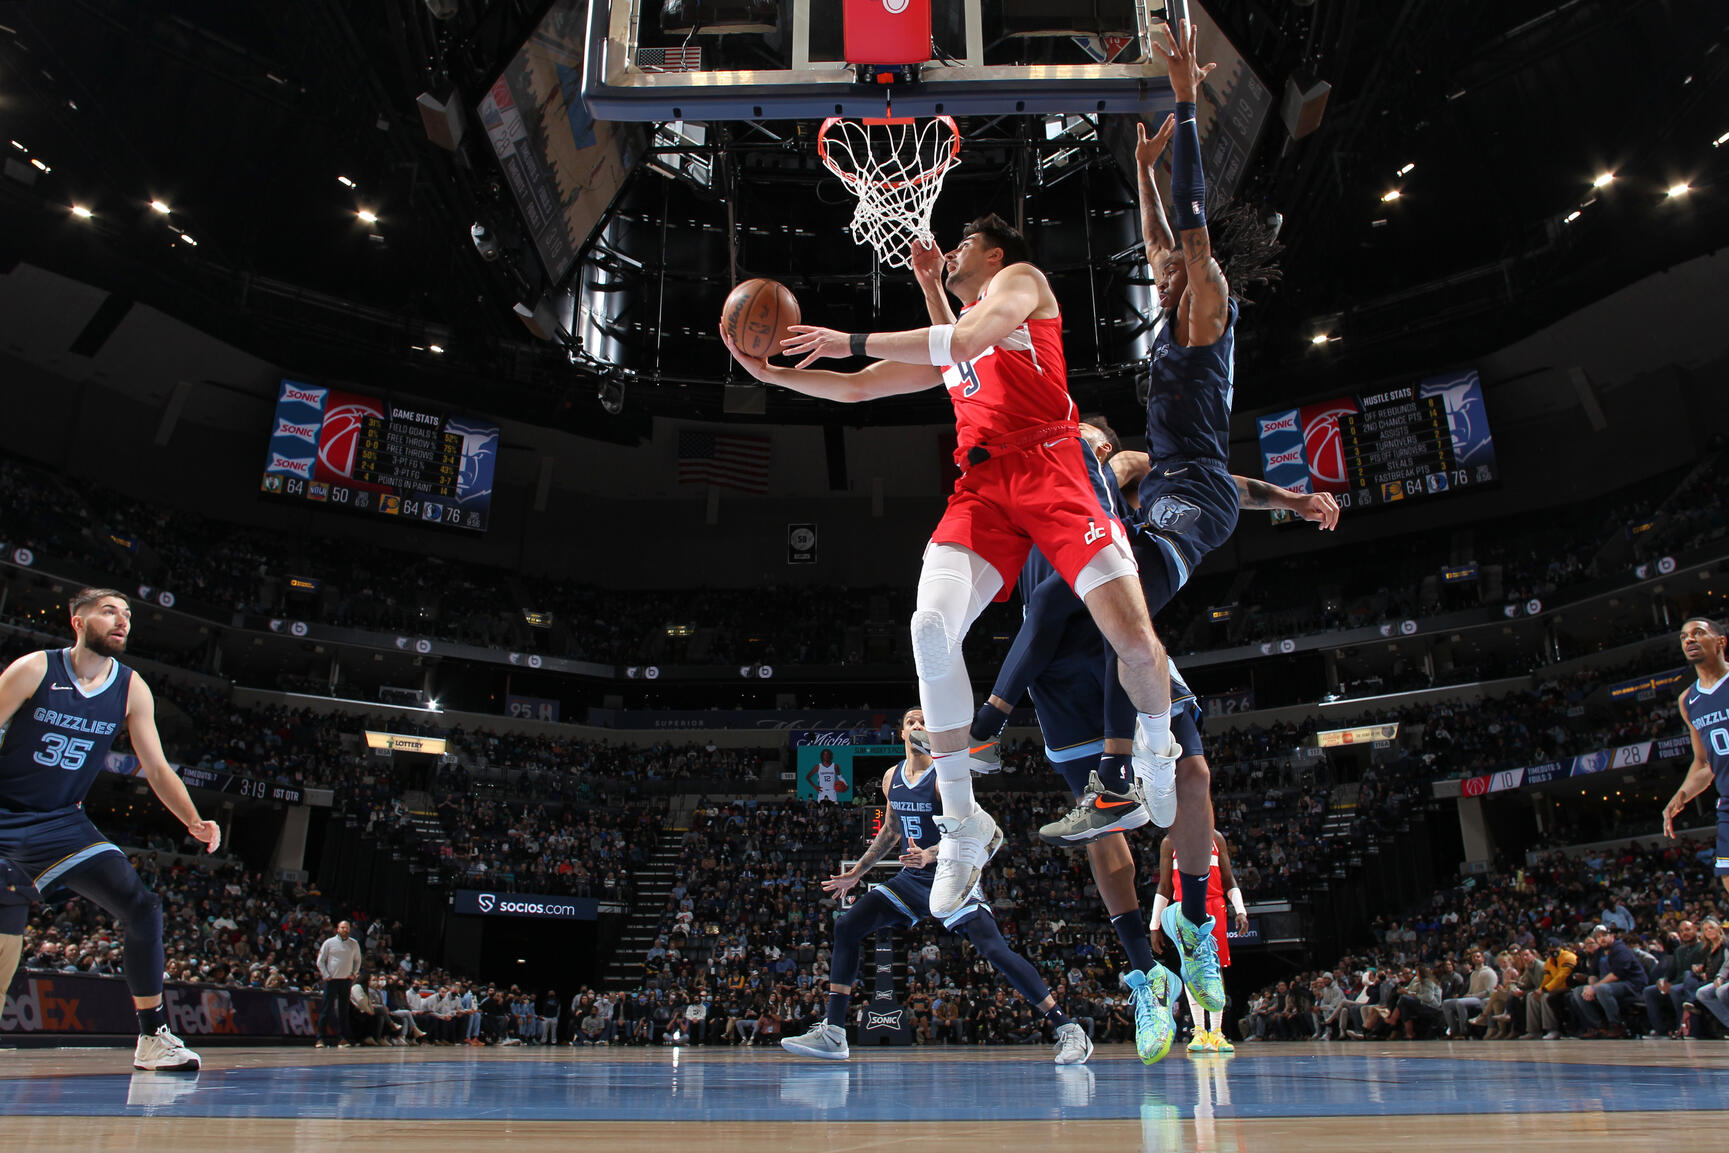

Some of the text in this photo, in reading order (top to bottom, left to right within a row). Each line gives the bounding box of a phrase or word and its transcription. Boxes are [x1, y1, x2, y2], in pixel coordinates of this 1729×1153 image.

[957, 361, 980, 398] 9
[287, 390, 319, 403] SONIC
[1363, 387, 1412, 406] HUSTLE STATS
[392, 408, 439, 426] GAME STATS
[1378, 402, 1417, 417] REBOUNDS
[388, 422, 408, 433] FIELD
[409, 427, 431, 438] GOALS
[1264, 418, 1293, 433] SONIC
[1379, 415, 1406, 429] CHANCE
[281, 424, 314, 437] SONIC
[1380, 425, 1409, 439] ASSISTS
[386, 432, 404, 443] FREE
[405, 436, 430, 448] THROW
[1376, 434, 1417, 451] TURNOVERS
[386, 444, 404, 455] FREE
[405, 447, 434, 460] THROWS
[1270, 451, 1298, 465] SONIC
[274, 458, 308, 471] SONIC
[378, 475, 403, 488] POINTS
[412, 482, 432, 493] PAINT
[1374, 468, 1415, 484] FASTBREAK
[1335, 469, 1468, 508] 50 64 76
[287, 478, 303, 495] 64
[332, 487, 348, 503] 50
[404, 500, 419, 516] 64
[447, 507, 461, 523] 76
[33, 707, 117, 735] GRIZZLIES
[395, 740, 424, 749] LOTTERY
[1710, 728, 1729, 756] 0
[33, 732, 95, 771] 35
[1623, 746, 1640, 764] 28
[1528, 763, 1555, 775] TIMEOUTS
[1501, 771, 1513, 788] 10
[240, 779, 267, 798] 3:19
[273, 788, 299, 801] 1ST QTR
[900, 816, 923, 839] 15
[0, 979, 84, 1031] edEx
[164, 989, 239, 1034] FedEx
[871, 1016, 897, 1024] SONIC
